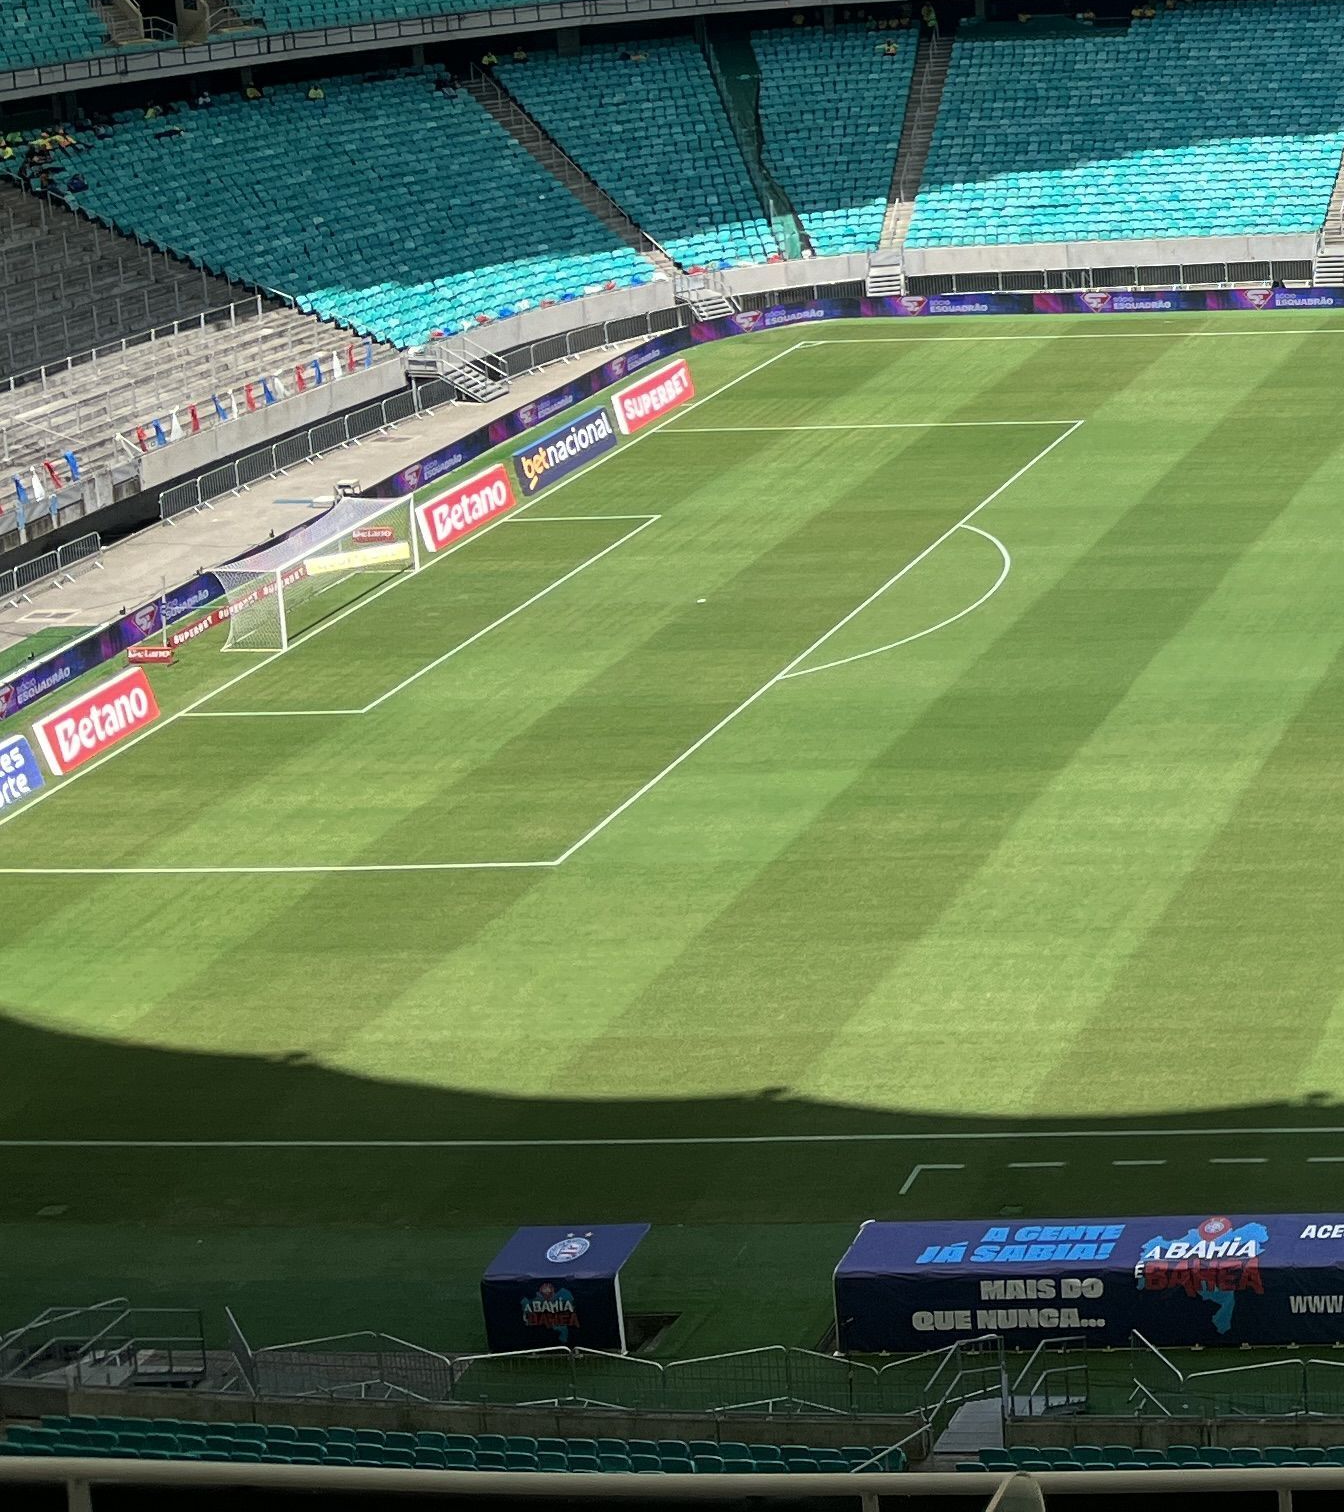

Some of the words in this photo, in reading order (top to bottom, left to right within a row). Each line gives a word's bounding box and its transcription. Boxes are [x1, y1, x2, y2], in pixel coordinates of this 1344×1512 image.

[930, 303, 988, 312] ESQUADRÃO
[1113, 300, 1171, 310] ESQUADRÃO
[1275, 296, 1333, 306] ESQUADRÃO
[765, 308, 825, 327] ESQUADRÃO
[623, 368, 688, 420] SUPERBET
[521, 411, 613, 483] betnacional
[432, 480, 507, 541] Betano
[174, 615, 213, 645] SUPERBET
[18, 666, 70, 705] ESQUADRÃO
[56, 687, 148, 763] Betano
[980, 1227, 1006, 1242] A
[1014, 1224, 1126, 1242] GENTE
[915, 1241, 969, 1264] JÁ
[970, 1241, 1116, 1263] SABIA!
[1143, 1245, 1160, 1259] A
[980, 1278, 1056, 1301] MAIS
[1061, 1277, 1104, 1299] DO
[912, 1309, 972, 1331] QUE
[977, 1307, 1106, 1330] NUNCA...
